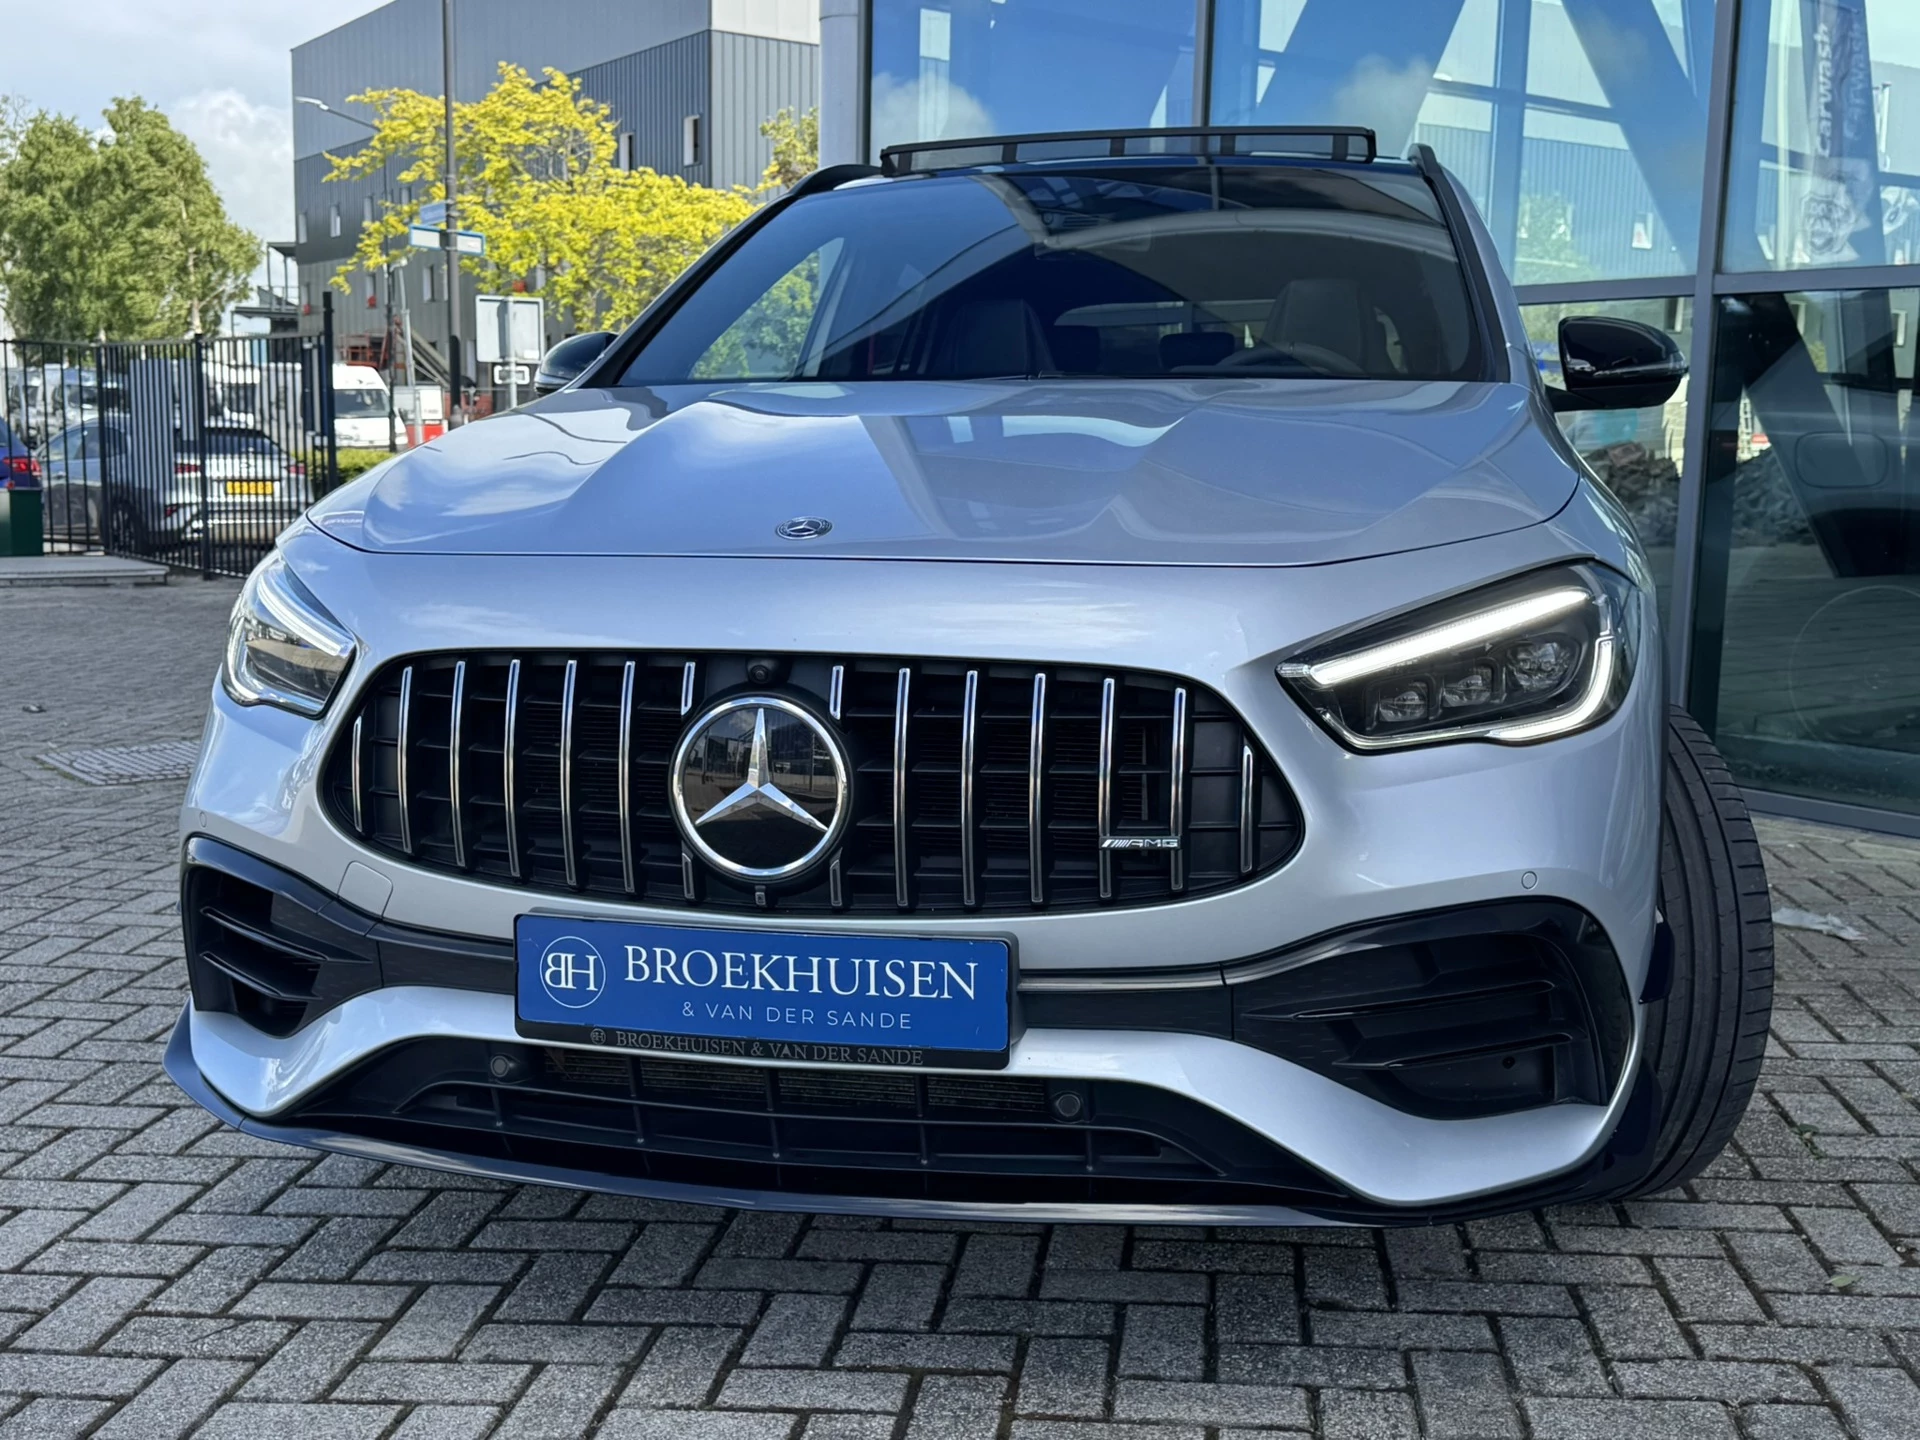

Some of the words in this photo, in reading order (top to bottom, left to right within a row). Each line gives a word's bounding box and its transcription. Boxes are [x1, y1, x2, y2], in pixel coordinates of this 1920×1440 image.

[624, 945, 979, 1000] BROEKHUISEN
[682, 1001, 695, 1017] &
[705, 1003, 752, 1021] VAN
[766, 1006, 814, 1024] DER
[827, 1010, 912, 1029] SANDE
[615, 1031, 745, 1056] BROEKHUISEN
[750, 1042, 765, 1057] &
[768, 1042, 809, 1060] VAN
[814, 1044, 853, 1062] DER
[857, 1047, 924, 1066] SANDE
